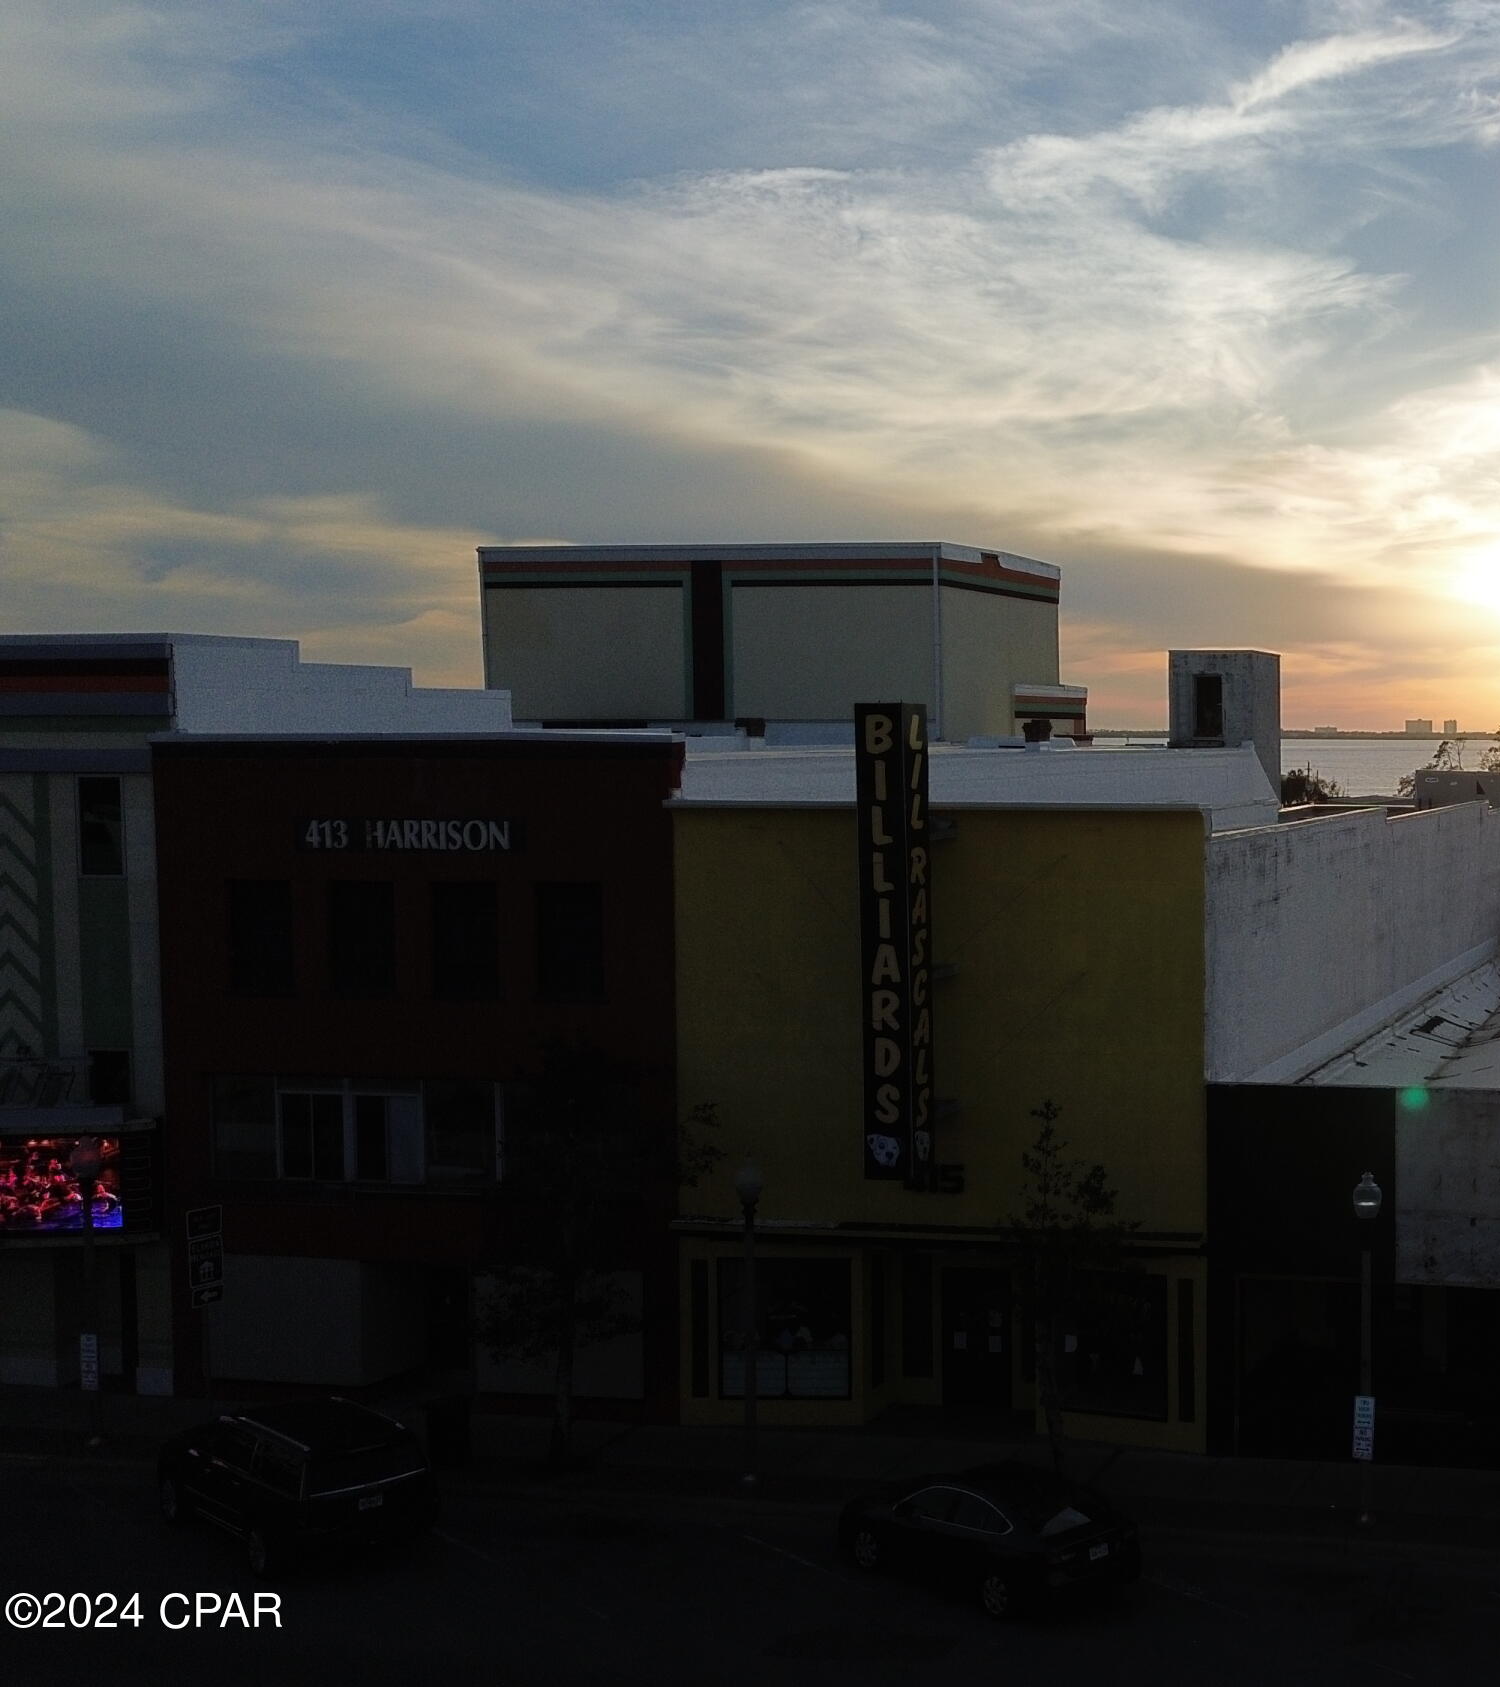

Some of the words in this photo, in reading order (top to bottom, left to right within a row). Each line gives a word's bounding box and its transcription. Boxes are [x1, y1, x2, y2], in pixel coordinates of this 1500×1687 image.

[306, 820, 348, 849] 413
[365, 820, 511, 850] HARRISON
[909, 715, 926, 830] LIL
[864, 713, 902, 1125] BILLIARDS
[909, 846, 930, 1128] RASCALS
